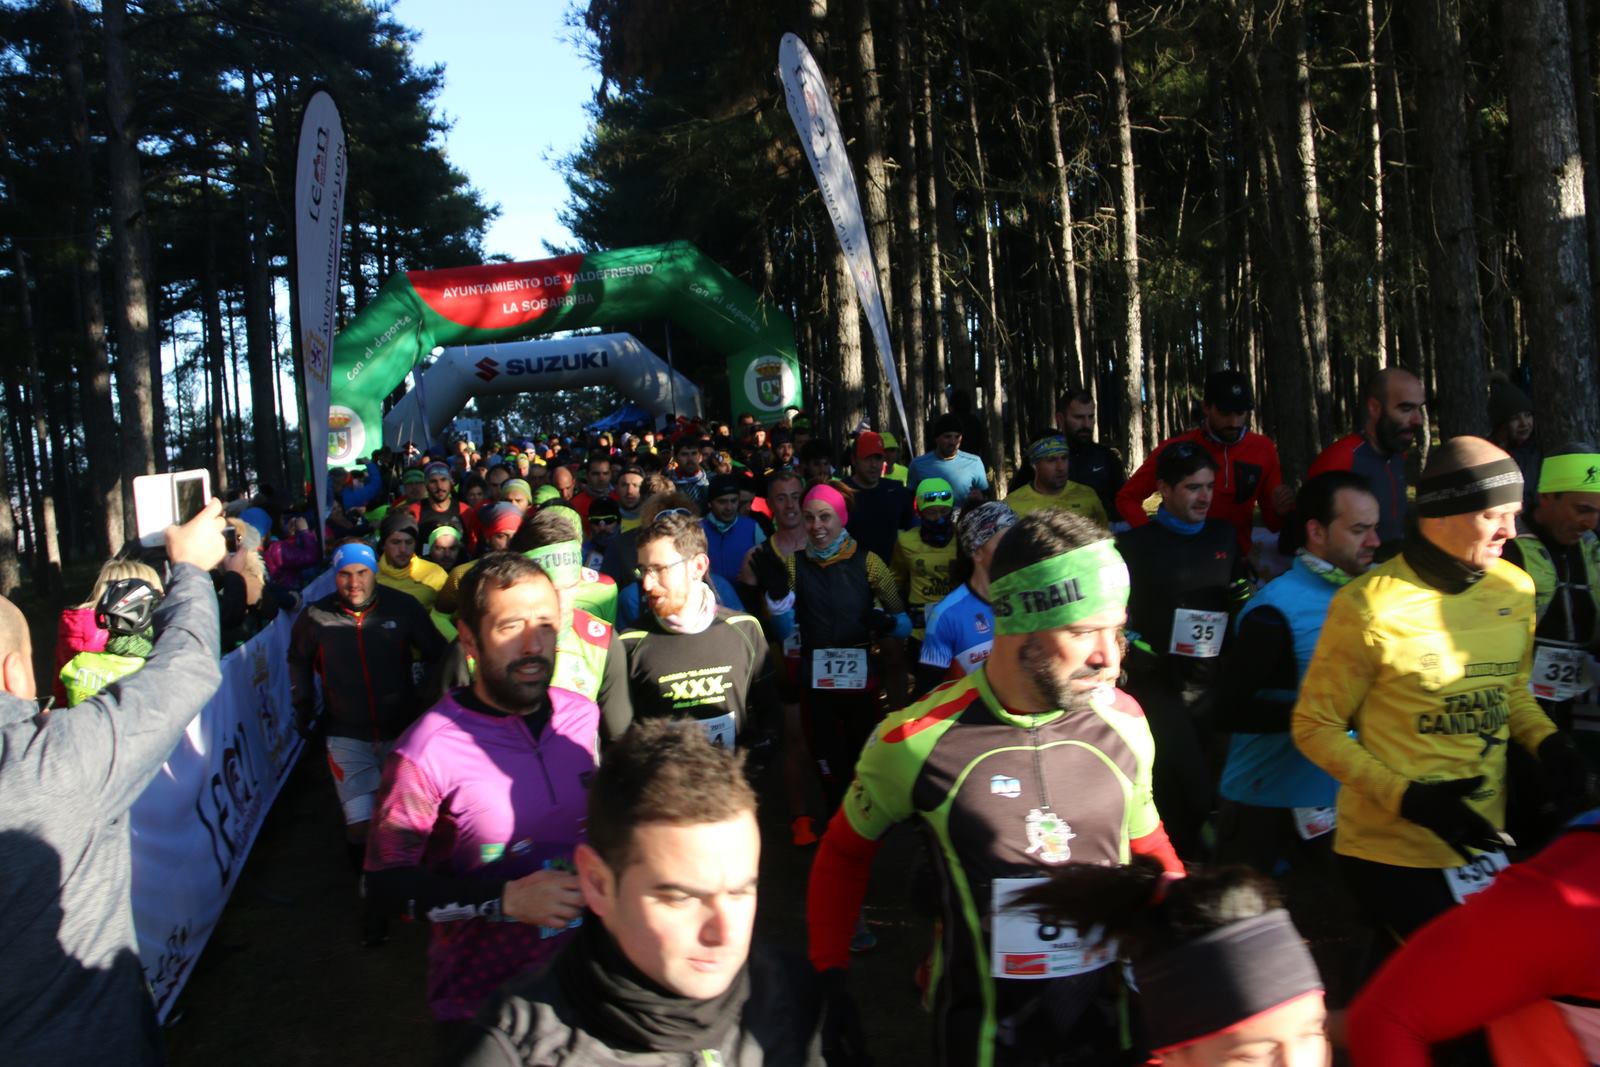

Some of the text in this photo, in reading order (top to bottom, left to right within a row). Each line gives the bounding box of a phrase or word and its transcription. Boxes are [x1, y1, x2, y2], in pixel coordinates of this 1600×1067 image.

[443, 264, 653, 298] AYUNTAMIENTO DE VALDEFRESNO
[689, 283, 710, 297] Con
[503, 294, 595, 314] LA SOBARRIBA
[347, 315, 412, 380] Con el deporte
[506, 351, 609, 376] SUZUKI
[1019, 578, 1086, 613] TRAIL
[1192, 624, 1214, 640] 35
[824, 660, 858, 674] 172
[670, 675, 724, 700] XXX
